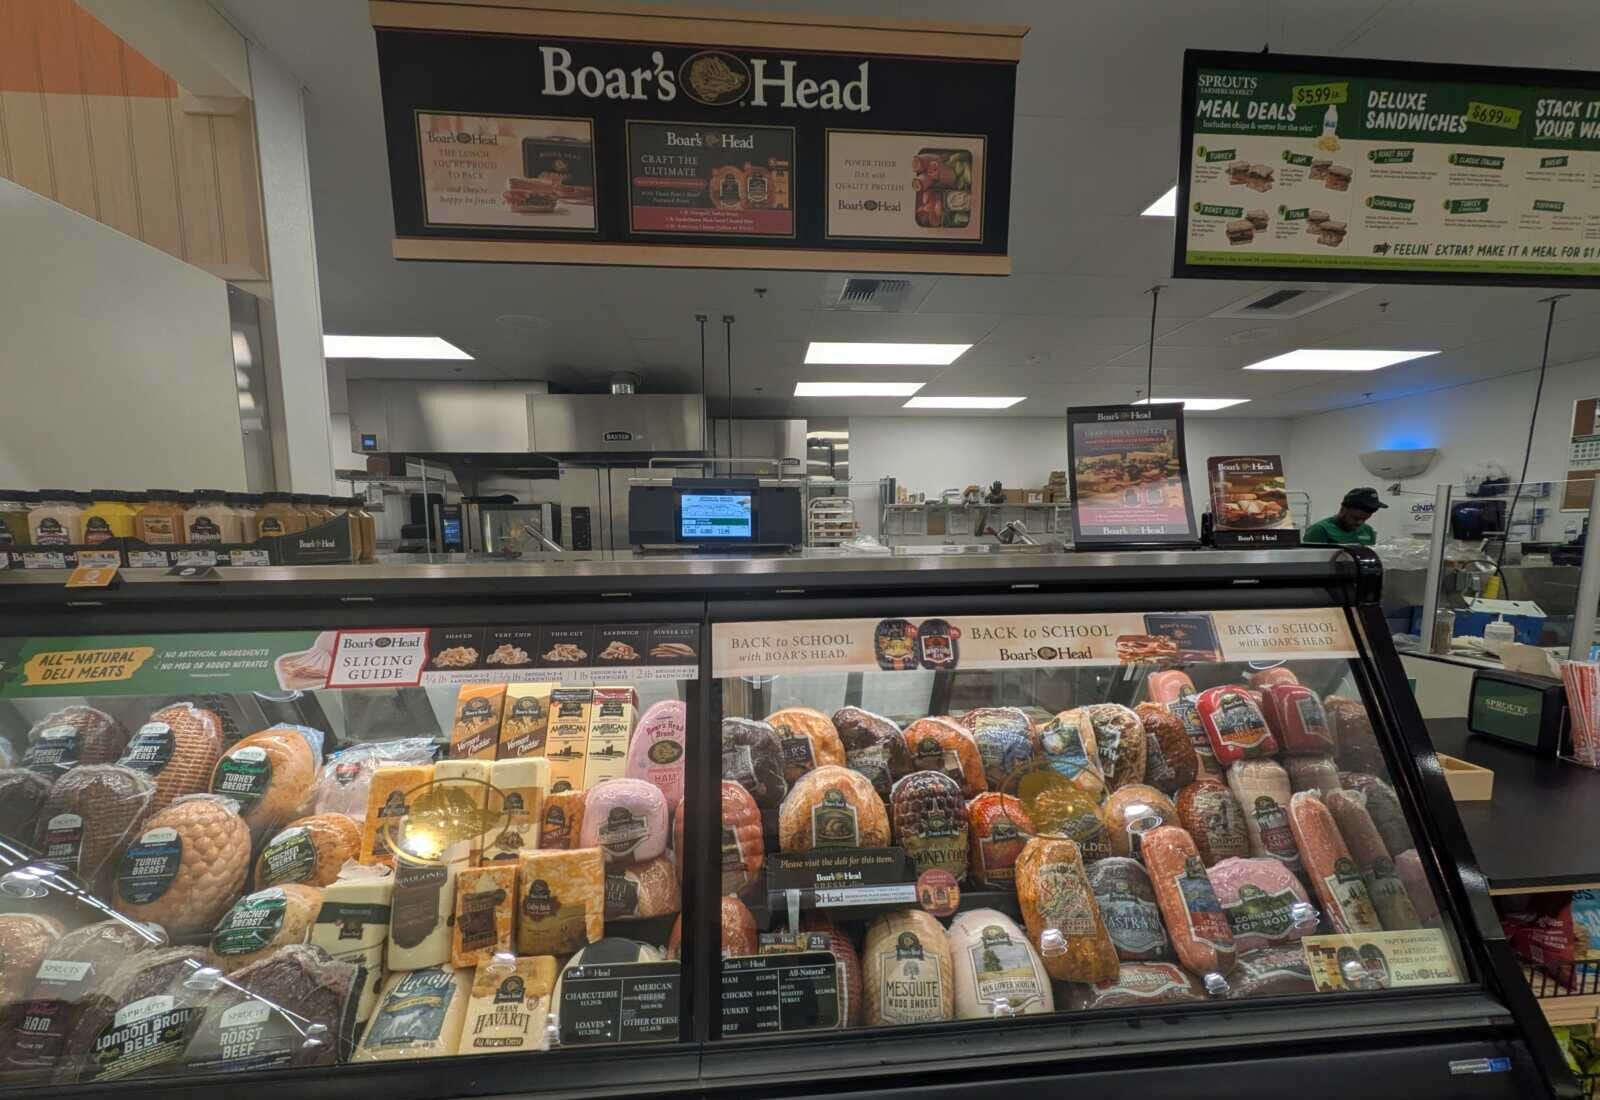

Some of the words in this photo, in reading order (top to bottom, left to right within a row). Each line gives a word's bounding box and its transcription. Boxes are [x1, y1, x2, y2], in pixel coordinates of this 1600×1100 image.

[539, 46, 677, 102] Boar's
[750, 59, 872, 113] Head
[1198, 74, 1258, 89] SPROUTS
[1368, 90, 1428, 111] DELUXE
[1197, 99, 1240, 119] MEAL
[1247, 101, 1297, 121] DEALS
[1536, 99, 1583, 118] STACK
[1366, 111, 1468, 134] SANDWICHES
[1535, 119, 1575, 138] YOUR
[1580, 121, 1600, 139] WA
[666, 131, 702, 147] Boar's
[721, 133, 754, 150] Head
[679, 155, 698, 166] THE
[644, 166, 697, 177] ULTIMATE
[1435, 243, 1474, 256] EXTRA?
[1477, 244, 1505, 257] MAKE
[1507, 244, 1519, 257] IT
[1521, 245, 1528, 257] A
[1531, 246, 1558, 257] MEAL
[1561, 245, 1580, 258] FOR
[1131, 411, 1152, 421] Head
[971, 627, 1018, 640] BACK
[1023, 627, 1037, 639] to
[1042, 624, 1113, 639] SCHOOL
[1228, 624, 1263, 636] BACK
[1268, 625, 1279, 635] to
[1283, 622, 1338, 634] SCHOOL
[343, 638, 374, 650] Boar's
[391, 637, 421, 649] Head
[732, 636, 771, 649] BACK
[776, 637, 789, 647] to
[793, 633, 854, 647] SCHOOL
[1239, 639, 1260, 648] with
[1263, 637, 1300, 648] BOAR'S
[38, 649, 136, 667] ALL-NATURAL
[165, 650, 178, 658] NO
[178, 649, 218, 658] ARTIFICIAL
[739, 652, 761, 663] with
[765, 650, 808, 661] BOAR'S
[1000, 647, 1038, 661] Boar's
[1058, 646, 1094, 660] Head
[160, 662, 171, 671] NO
[205, 660, 231, 670] ADDED
[343, 655, 413, 668] SLICING
[41, 666, 73, 681] DELI
[78, 664, 125, 680] MEATS
[348, 668, 404, 680] GUIDE
[224, 773, 256, 783] TURKEY
[222, 781, 253, 792] BREAST
[136, 856, 168, 867] TURKEY
[780, 860, 804, 869] Please
[821, 858, 833, 867] the
[861, 855, 875, 864] this
[132, 865, 166, 876] BREAST
[822, 894, 844, 903] Head
[233, 909, 270, 920] CHICKEN
[1232, 921, 1259, 932] TOP
[594, 968, 611, 977] Head
[722, 976, 739, 984] HAM
[633, 982, 673, 992] AMERICAN
[886, 981, 938, 998] MESQUITE
[565, 990, 619, 1001] CHARCUTERIE
[721, 990, 753, 1000] CHICKEN
[722, 1006, 749, 1015] TURKEY
[473, 1012, 531, 1034] HAVARTI
[575, 1021, 605, 1030] LOAVES
[623, 1018, 650, 1027] OTHER
[96, 1021, 149, 1052] LONDON
[124, 1031, 163, 1054] BEEF
[219, 1026, 265, 1047] ROAST
[222, 1042, 256, 1059] BEEF
